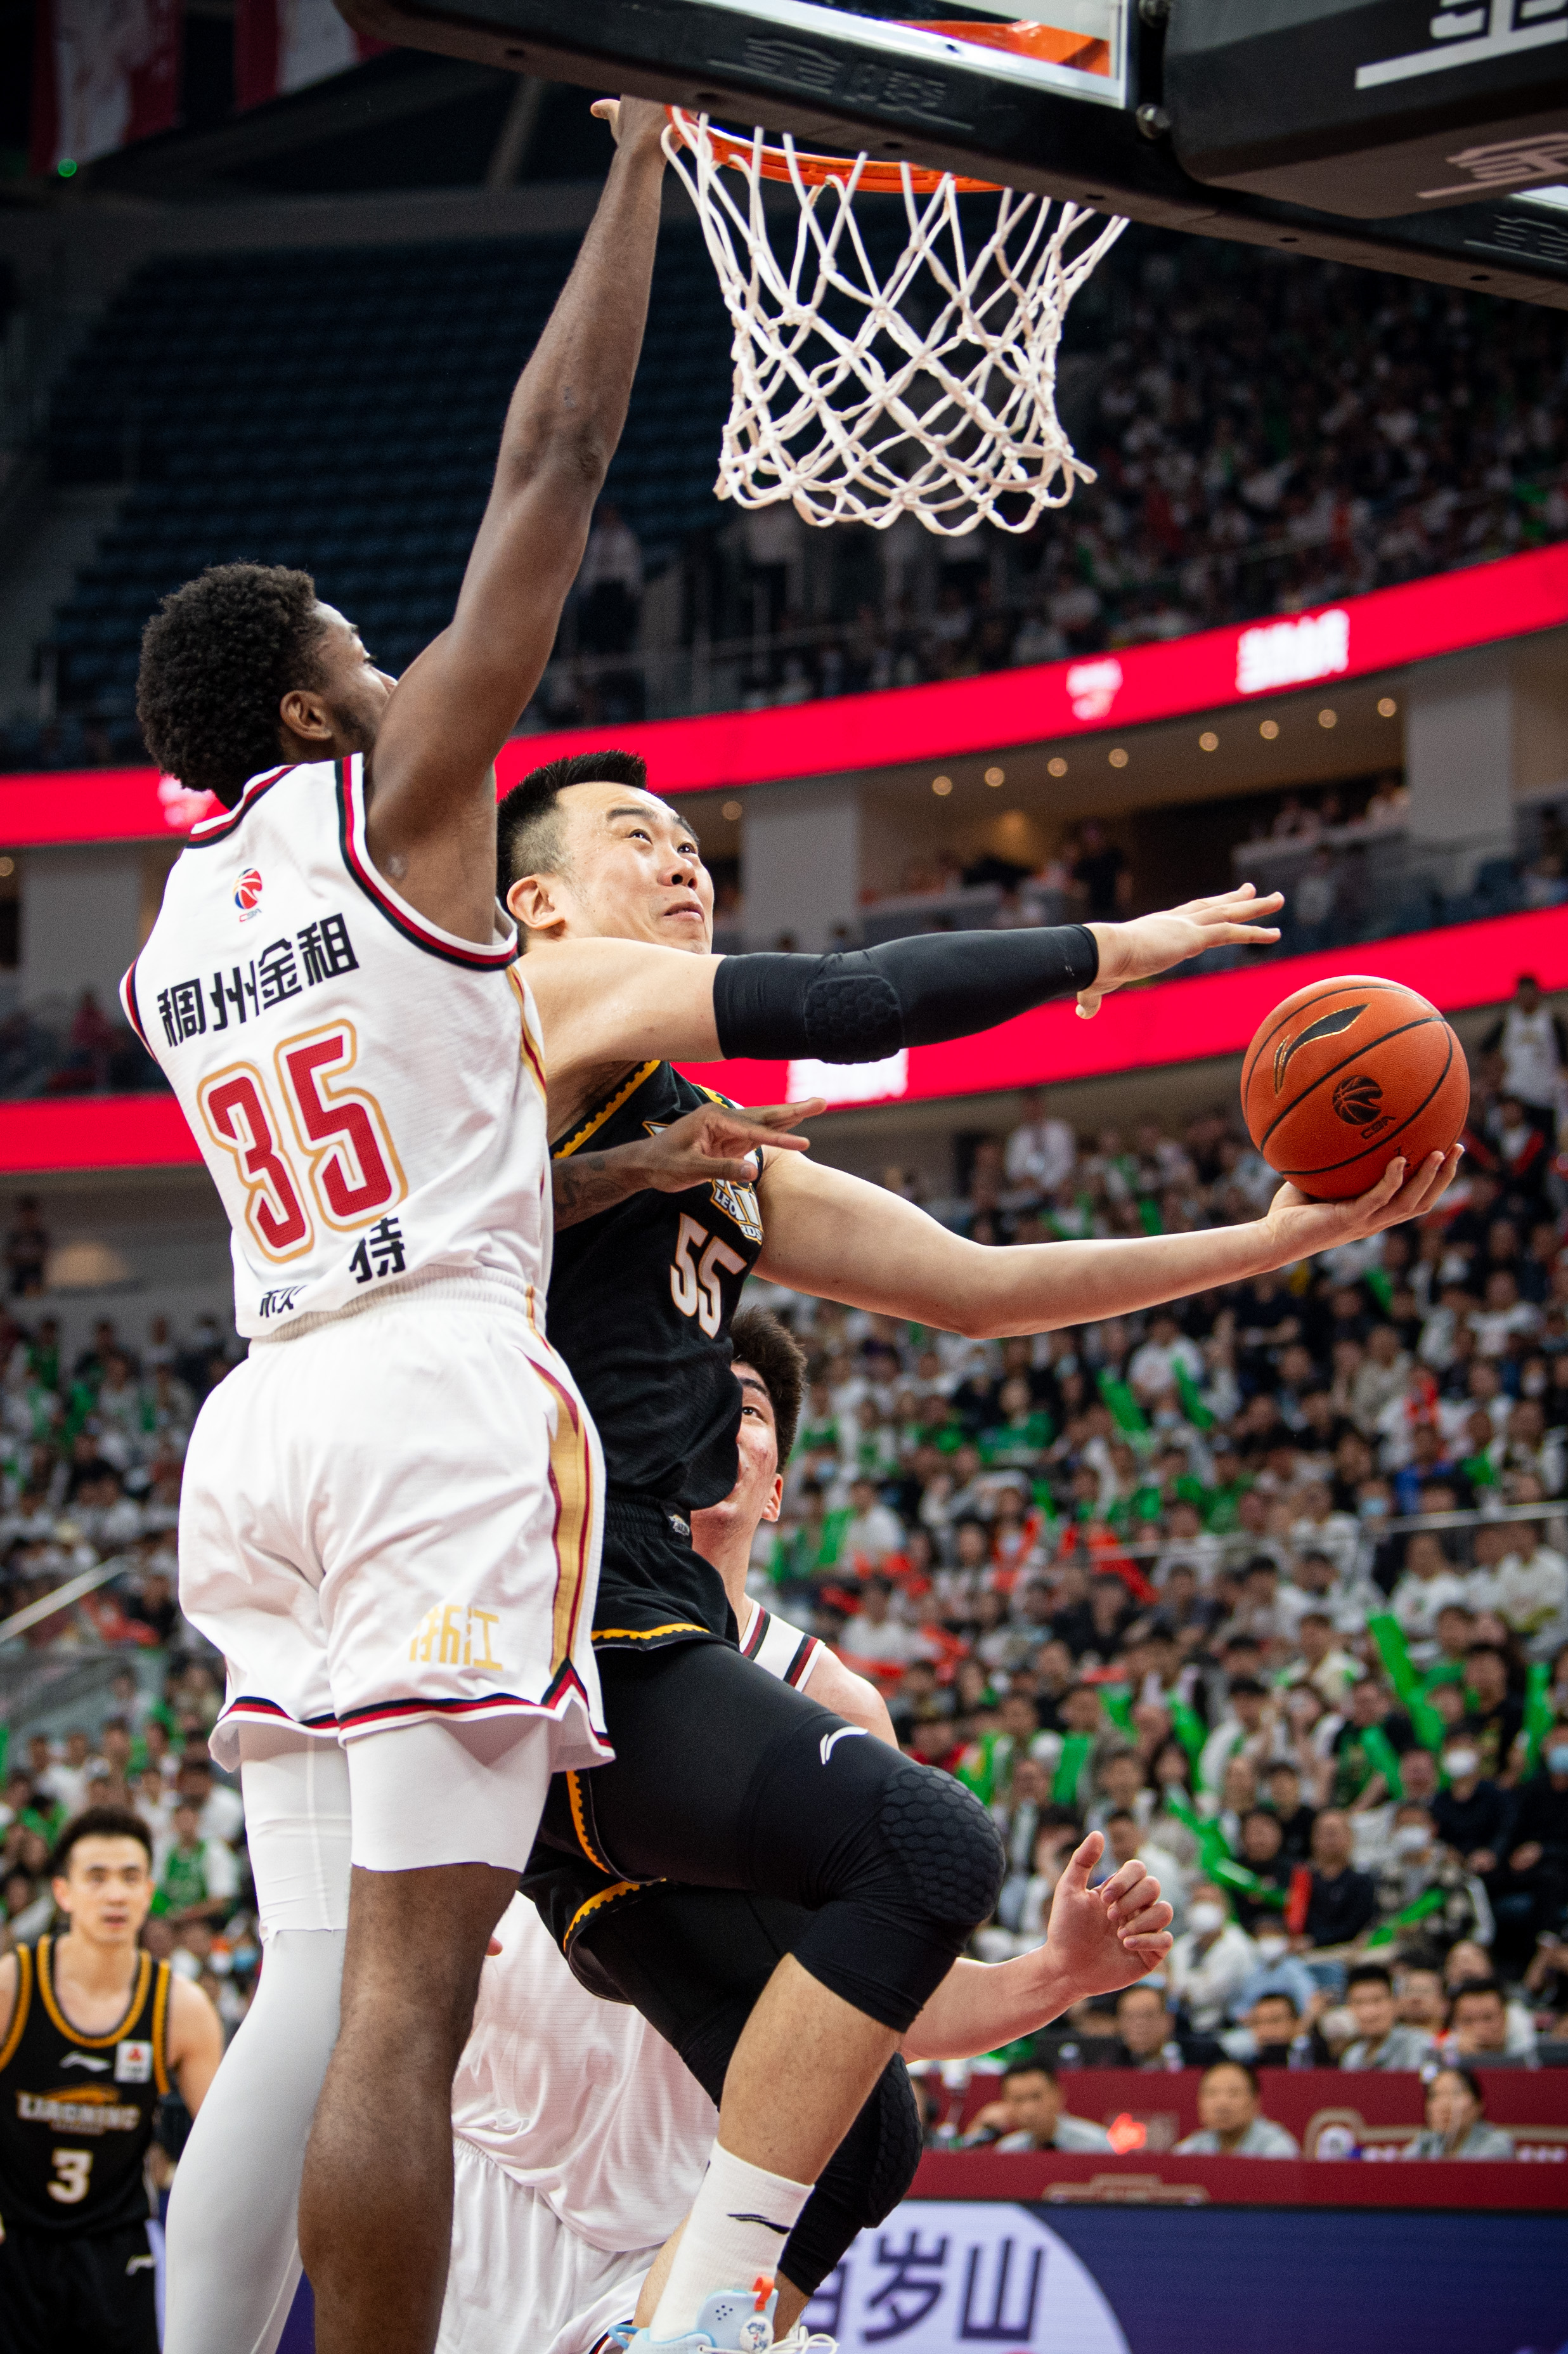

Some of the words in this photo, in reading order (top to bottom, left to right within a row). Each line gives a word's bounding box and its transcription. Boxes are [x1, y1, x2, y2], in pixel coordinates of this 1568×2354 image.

[240, 907, 262, 922] CBA
[157, 912, 360, 1048] 稠州金租
[197, 1018, 408, 1265] 35
[1361, 1115, 1397, 1140] CBA
[670, 1212, 748, 1339] 55
[46, 2147, 94, 2205] 3
